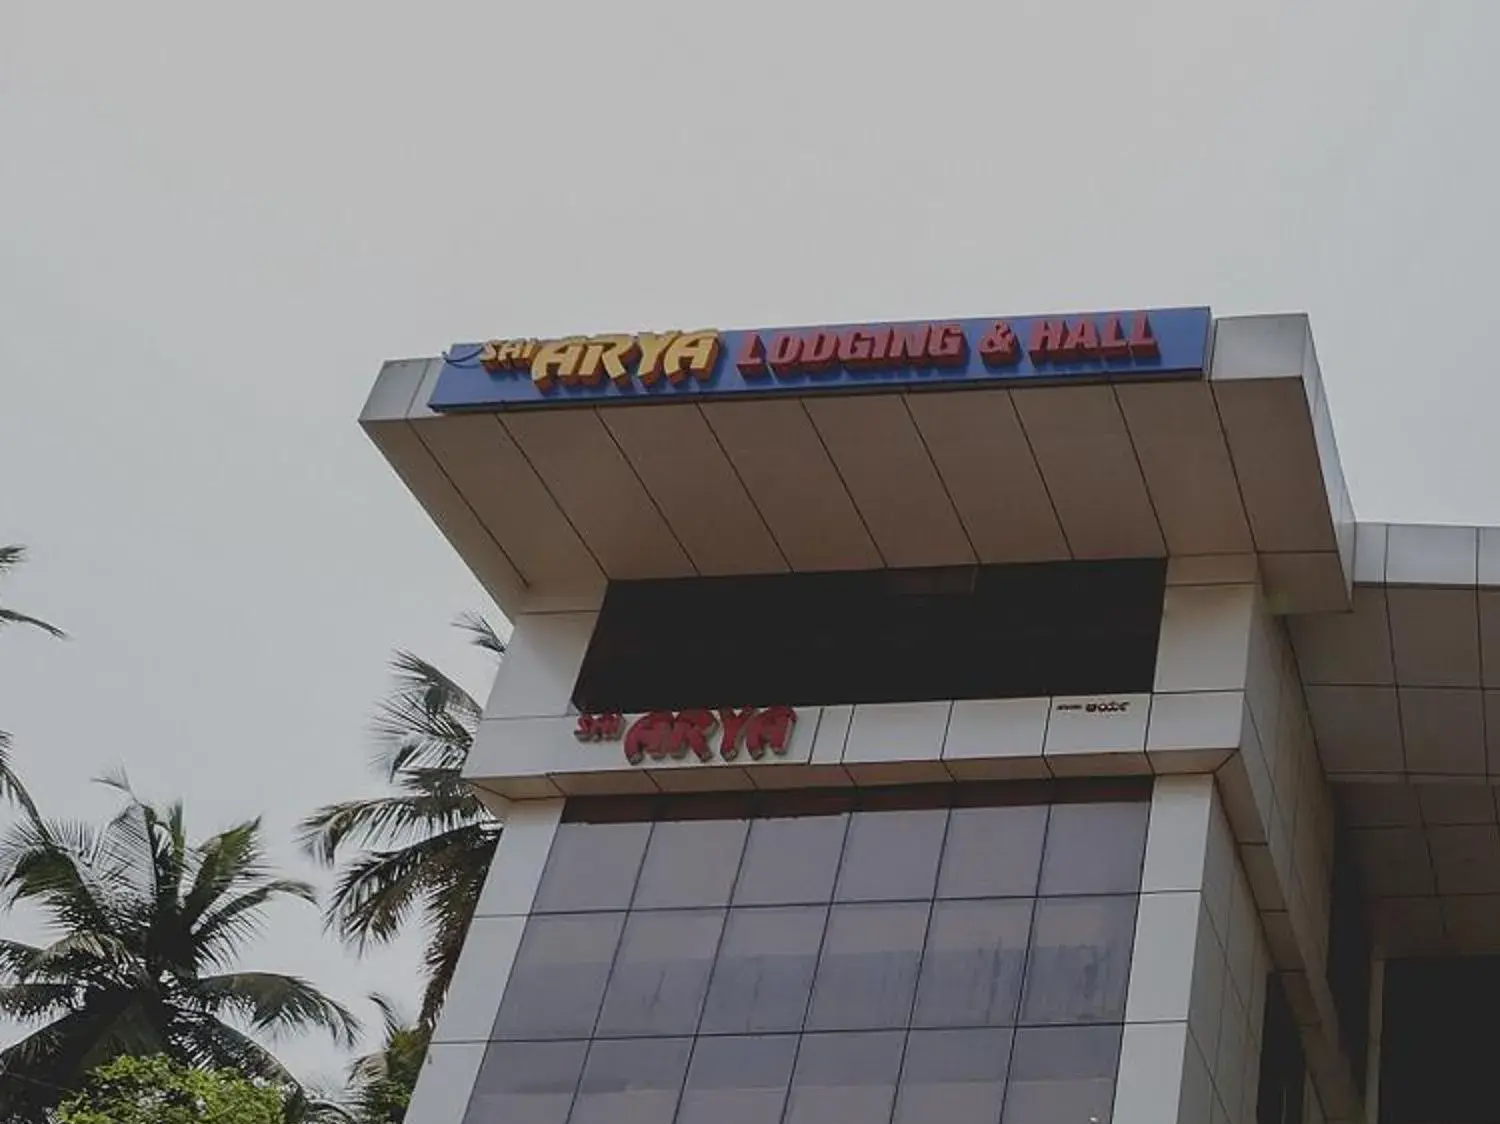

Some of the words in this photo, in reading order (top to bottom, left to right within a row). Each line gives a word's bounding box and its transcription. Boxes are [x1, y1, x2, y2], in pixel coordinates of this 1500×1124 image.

[531, 330, 724, 394] ARYA
[736, 322, 972, 380] LODGING
[979, 320, 1021, 368] &
[1028, 313, 1161, 369] HALL
[624, 703, 798, 766] ARYA
